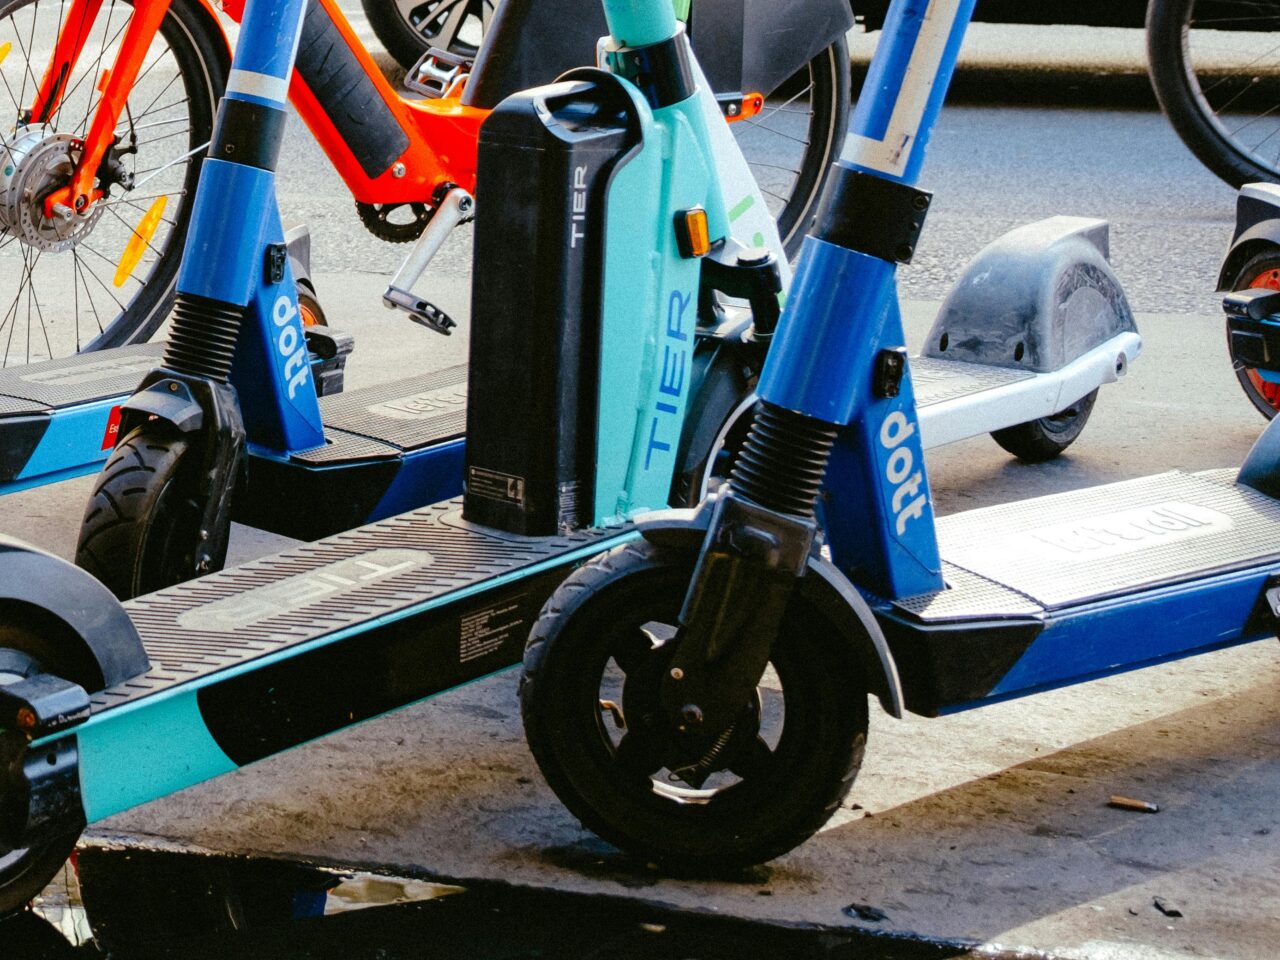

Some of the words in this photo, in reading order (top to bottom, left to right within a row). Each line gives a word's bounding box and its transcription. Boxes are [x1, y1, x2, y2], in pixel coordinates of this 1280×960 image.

[571, 164, 588, 249] TIER
[272, 295, 309, 400] dott
[644, 289, 692, 471] TIER
[880, 410, 927, 536] dott
